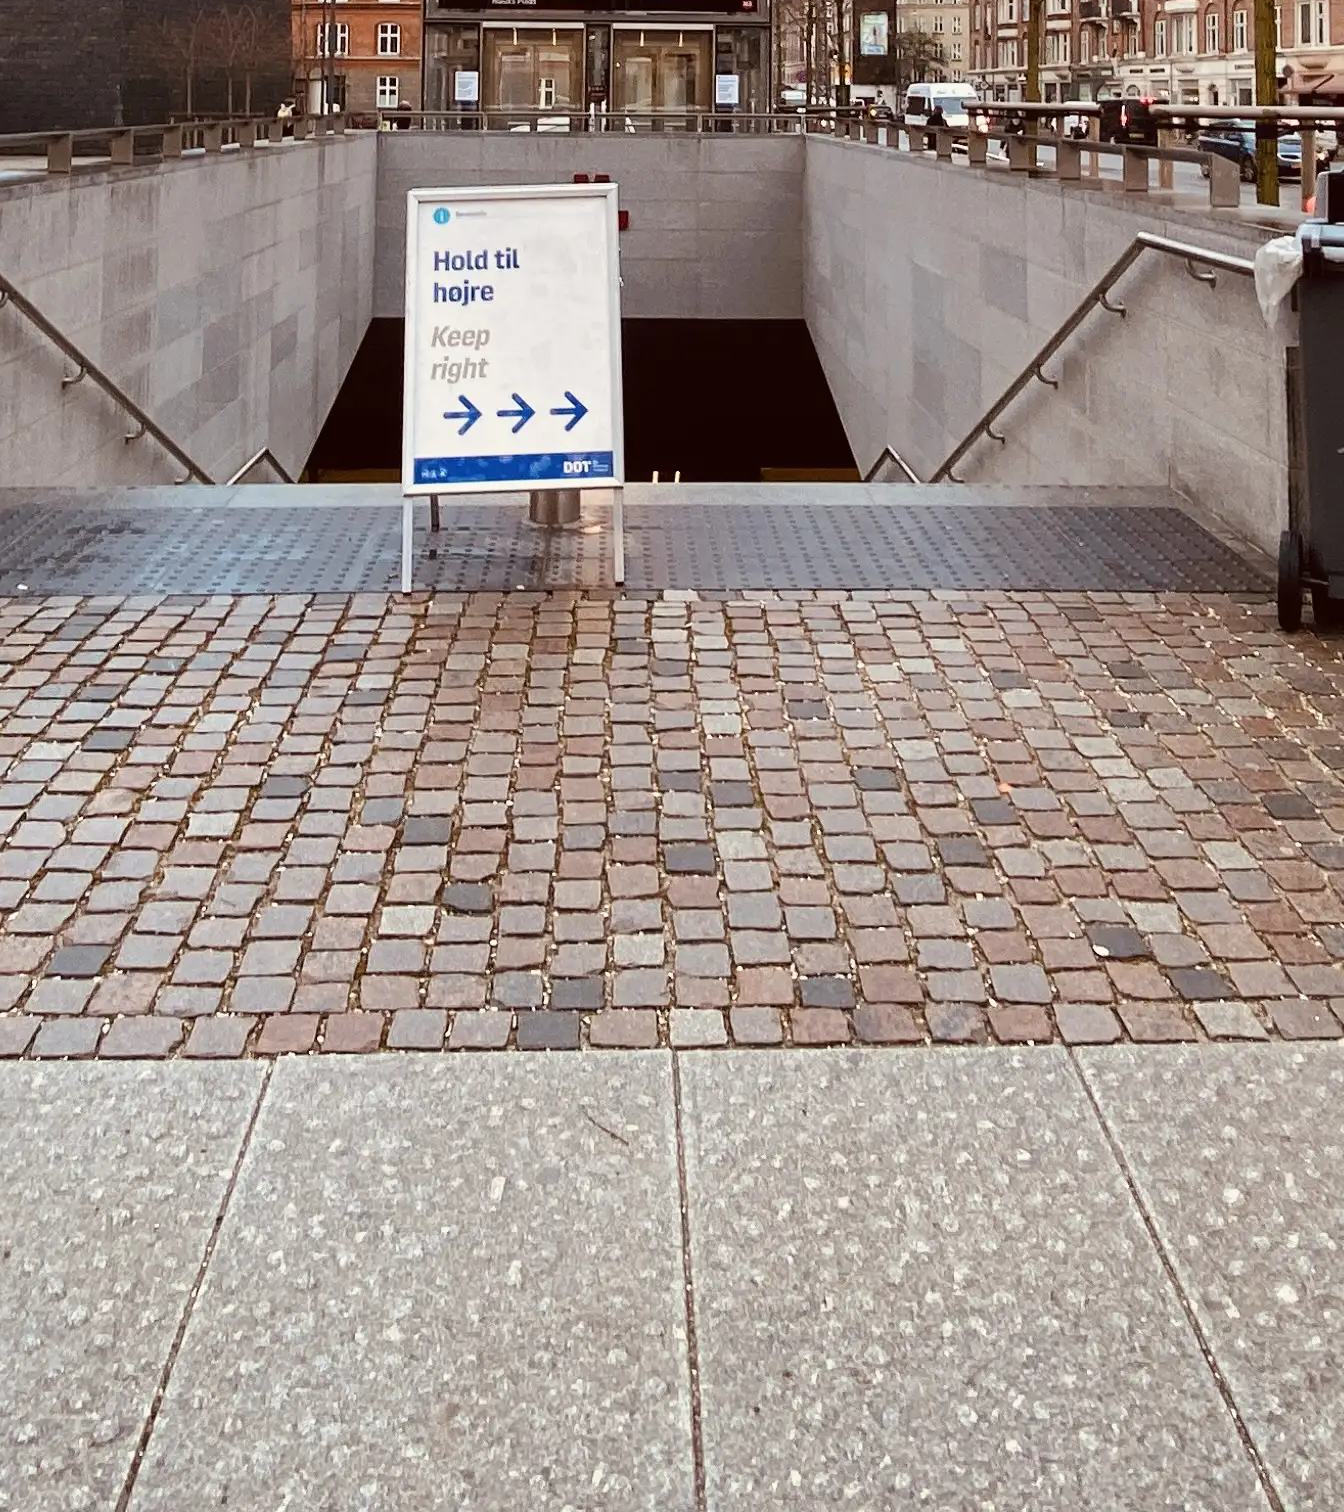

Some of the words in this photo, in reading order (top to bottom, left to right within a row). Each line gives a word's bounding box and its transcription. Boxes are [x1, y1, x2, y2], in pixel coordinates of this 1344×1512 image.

[434, 250, 488, 271] Hold
[494, 247, 520, 269] til
[434, 280, 494, 306] højre
[431, 326, 490, 350] Keep
[430, 356, 489, 384] right
[563, 460, 591, 474] DOT
